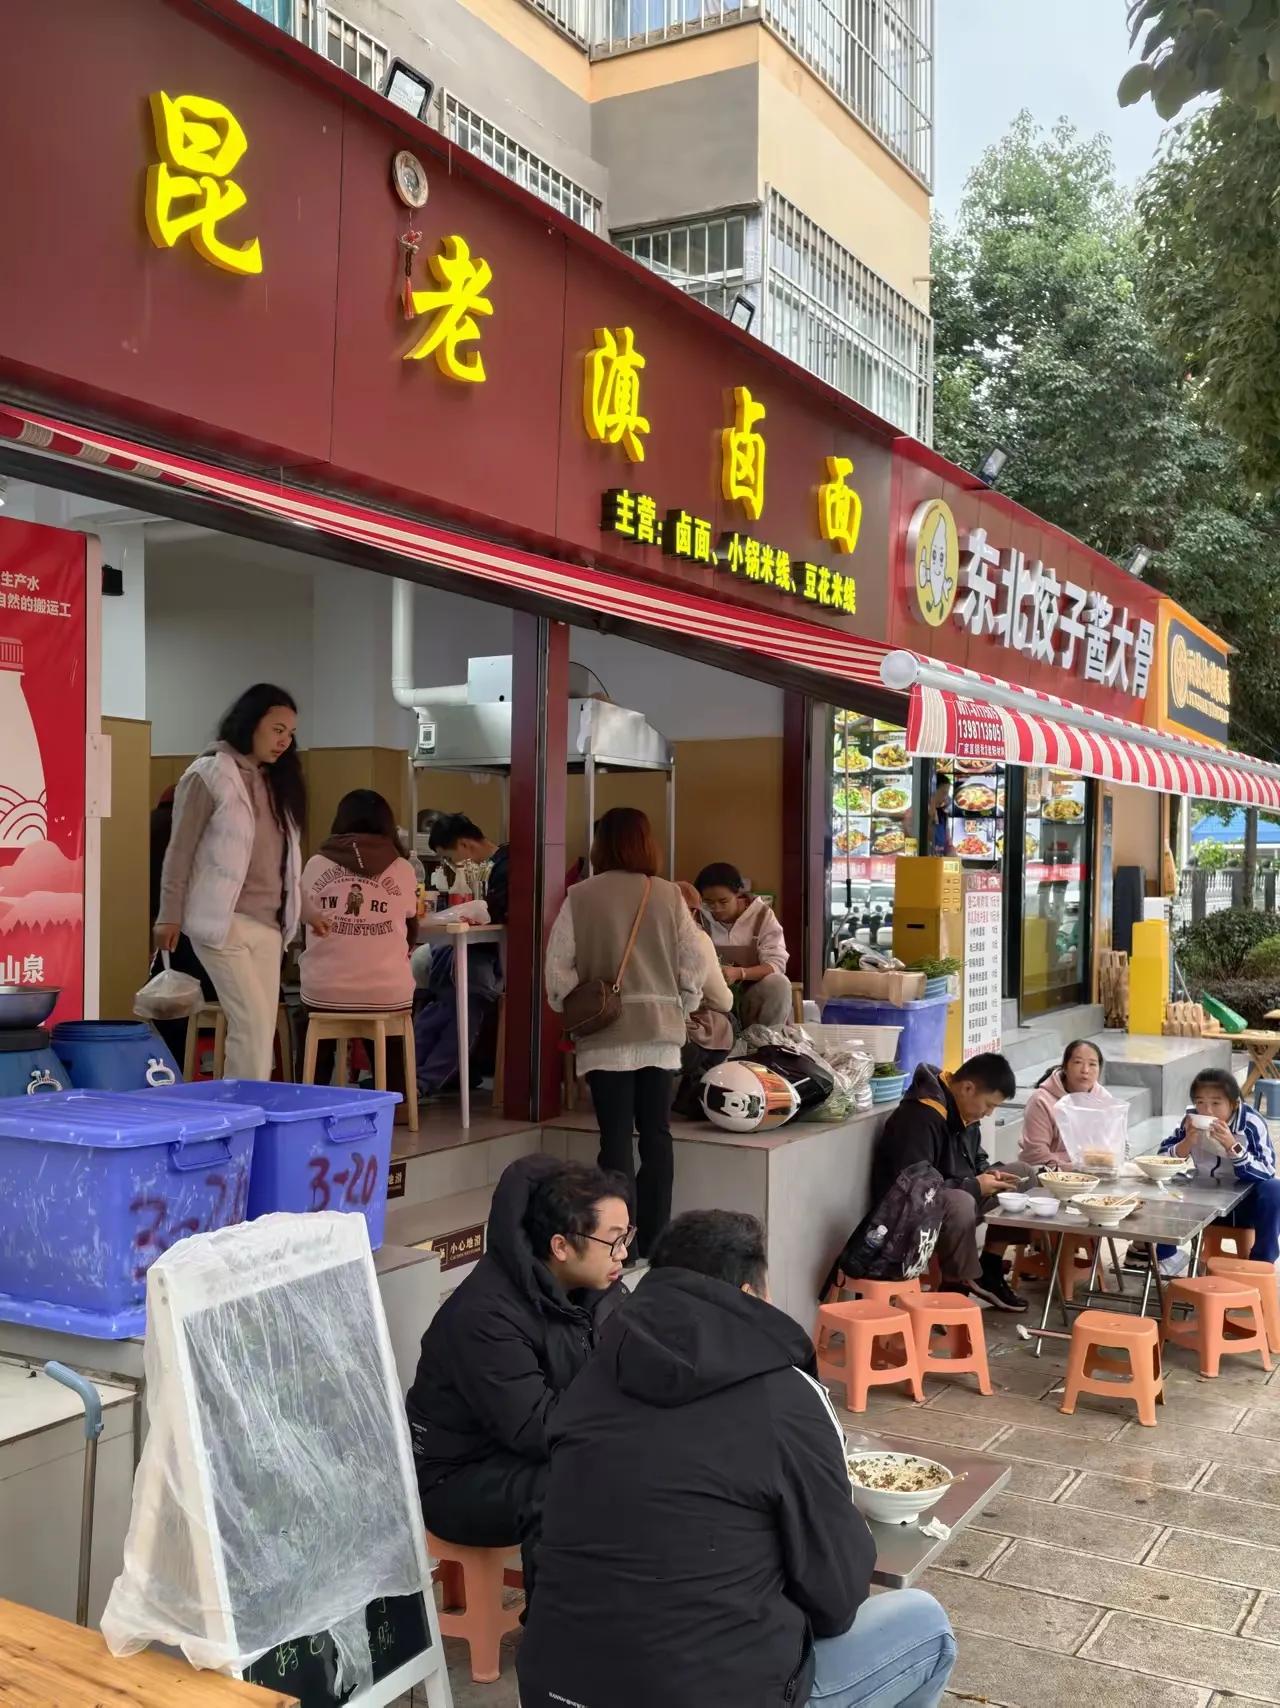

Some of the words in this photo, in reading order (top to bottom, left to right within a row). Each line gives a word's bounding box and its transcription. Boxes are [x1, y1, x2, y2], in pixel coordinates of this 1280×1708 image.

[146, 90, 864, 556] 昆老滇卤面
[1, 570, 40, 591] 生产水
[955, 528, 1155, 699] 东北饺子酱大骨
[321, 896, 338, 909] TW
[370, 899, 388, 914] RC
[0, 953, 45, 985] 山泉
[308, 1151, 378, 1212] 3-20
[449, 1234, 481, 1255] 小心地滑
